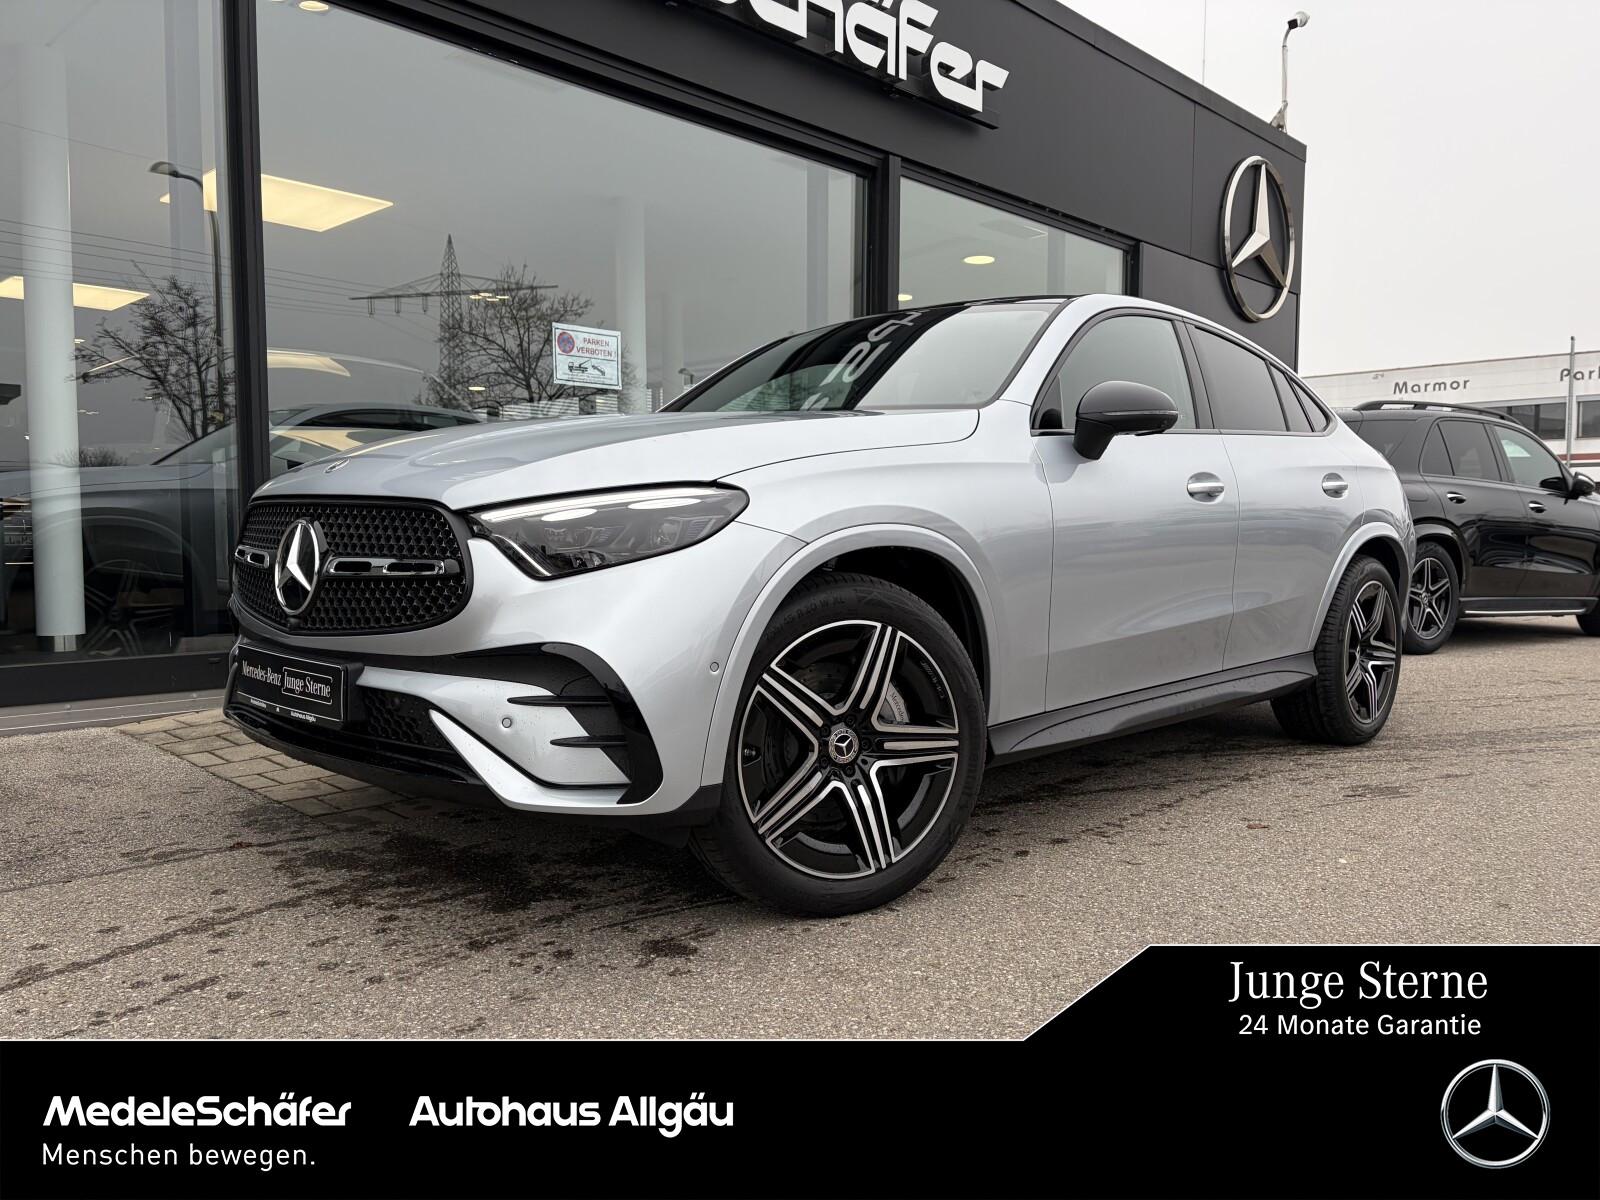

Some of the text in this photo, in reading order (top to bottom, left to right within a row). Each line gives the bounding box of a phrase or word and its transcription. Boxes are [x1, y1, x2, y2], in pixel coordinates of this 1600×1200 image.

[583, 337, 610, 347] PARKEN
[576, 346, 613, 358] VERBOTEN
[1393, 379, 1470, 395] Marmor
[242, 660, 331, 698] Mercedes-Benz Junge Sterne
